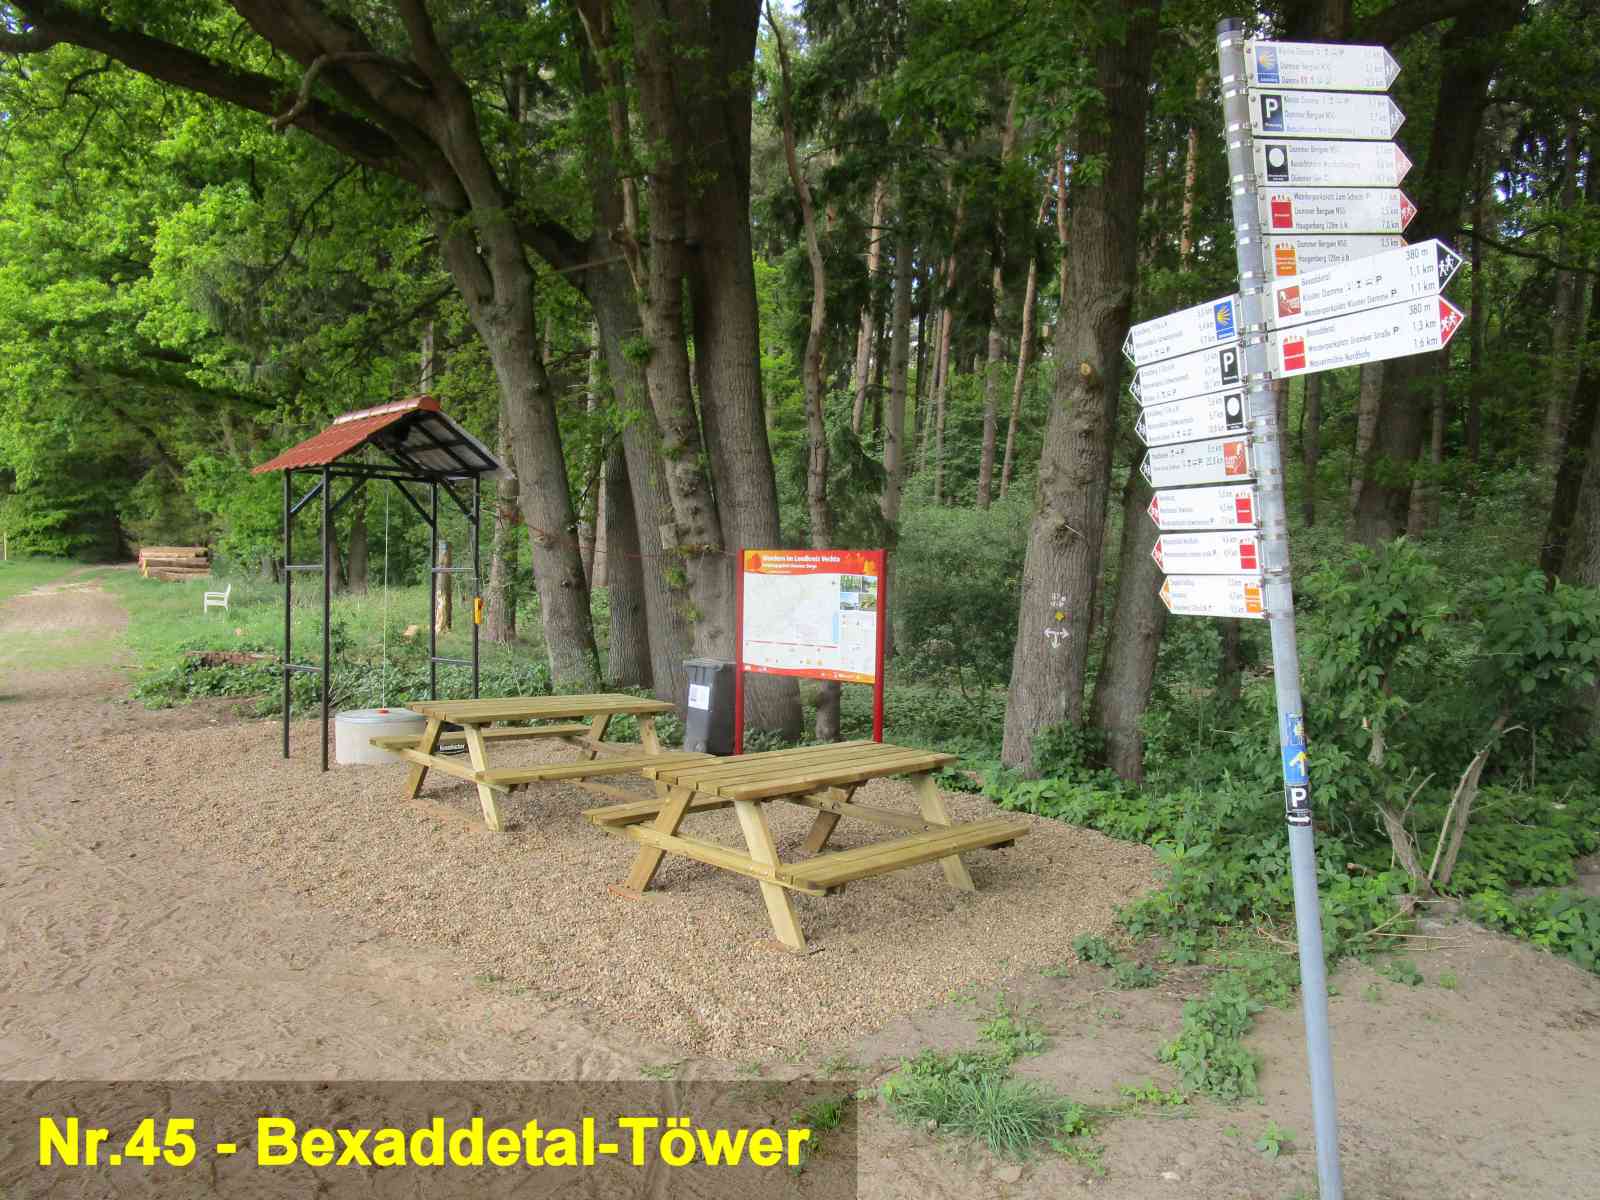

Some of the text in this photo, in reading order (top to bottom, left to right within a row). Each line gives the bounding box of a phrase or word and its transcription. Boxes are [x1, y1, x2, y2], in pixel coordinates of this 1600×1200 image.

[1390, 239, 1399, 247] km
[1406, 248, 1420, 260] 380
[1422, 263, 1434, 273] km
[1423, 281, 1435, 291] km
[1408, 305, 1422, 315] 380
[1425, 319, 1437, 328] km
[1426, 336, 1438, 346] km
